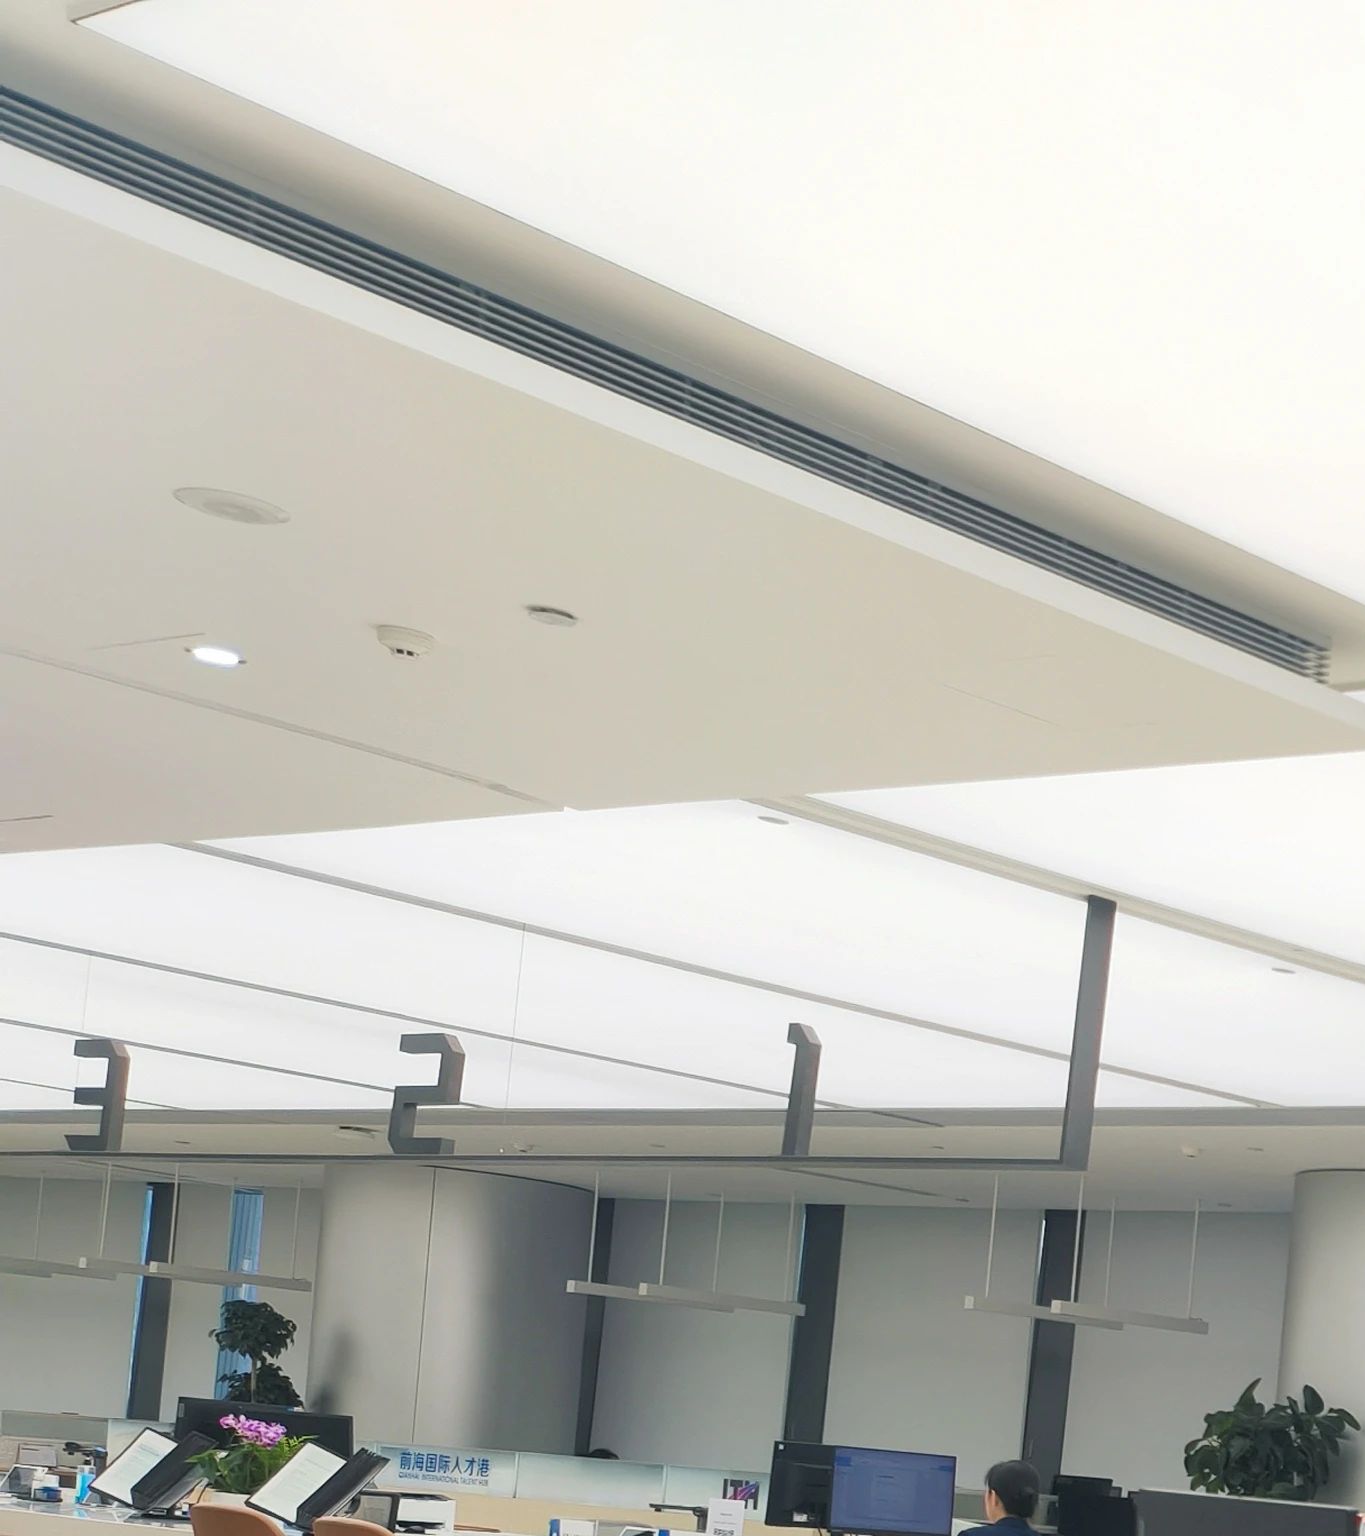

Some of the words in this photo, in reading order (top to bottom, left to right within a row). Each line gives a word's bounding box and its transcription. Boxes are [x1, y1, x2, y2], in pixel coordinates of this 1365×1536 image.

[64, 1038, 129, 1151] 3
[388, 1032, 464, 1155] 2
[783, 1022, 822, 1155] 1
[400, 1452, 490, 1477] 前海国际人才港
